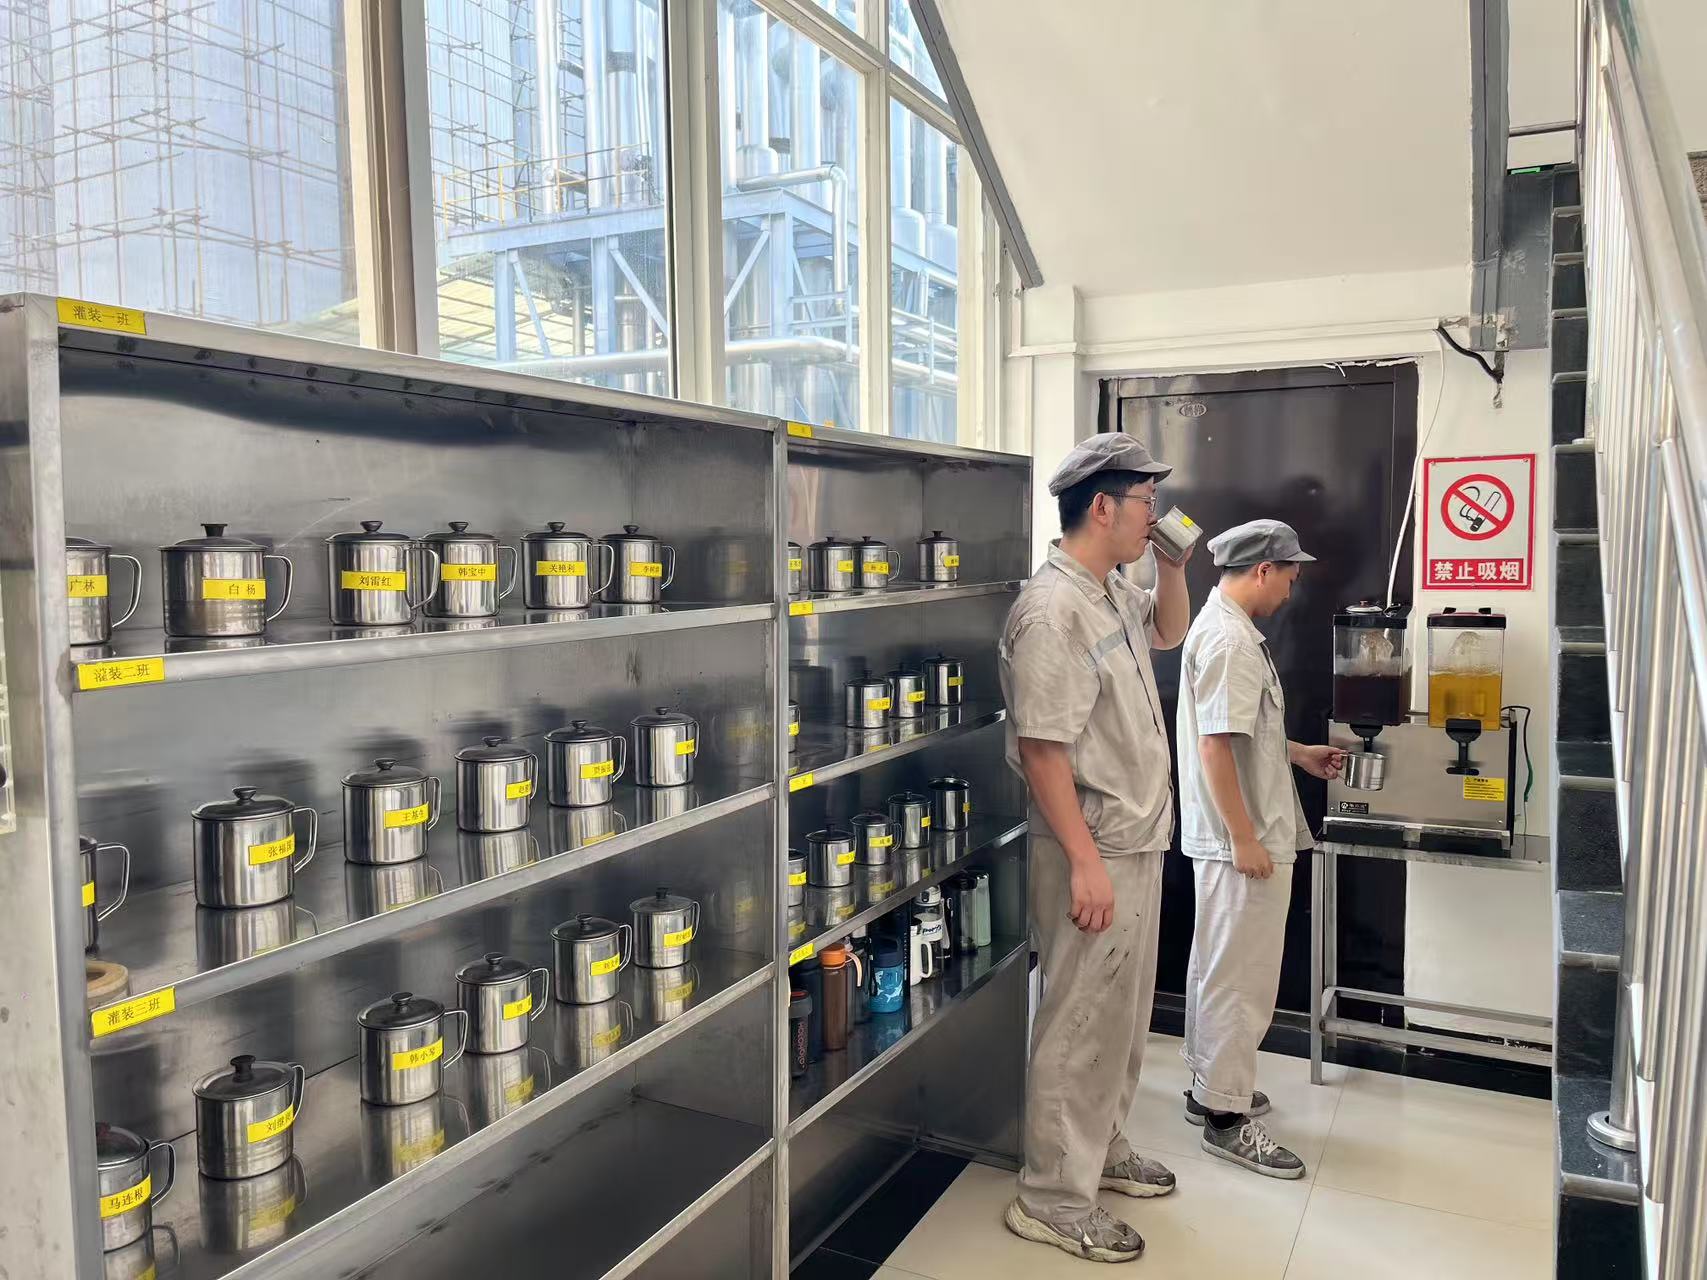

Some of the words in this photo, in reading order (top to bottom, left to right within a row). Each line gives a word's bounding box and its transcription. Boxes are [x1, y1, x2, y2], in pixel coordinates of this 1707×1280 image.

[73, 304, 129, 326] 灌装一班
[1434, 561, 1519, 580] 禁止吸烟
[94, 663, 151, 682] 灌装二班
[107, 997, 161, 1026] 灌装三班
[108, 1186, 144, 1210] 马连根
